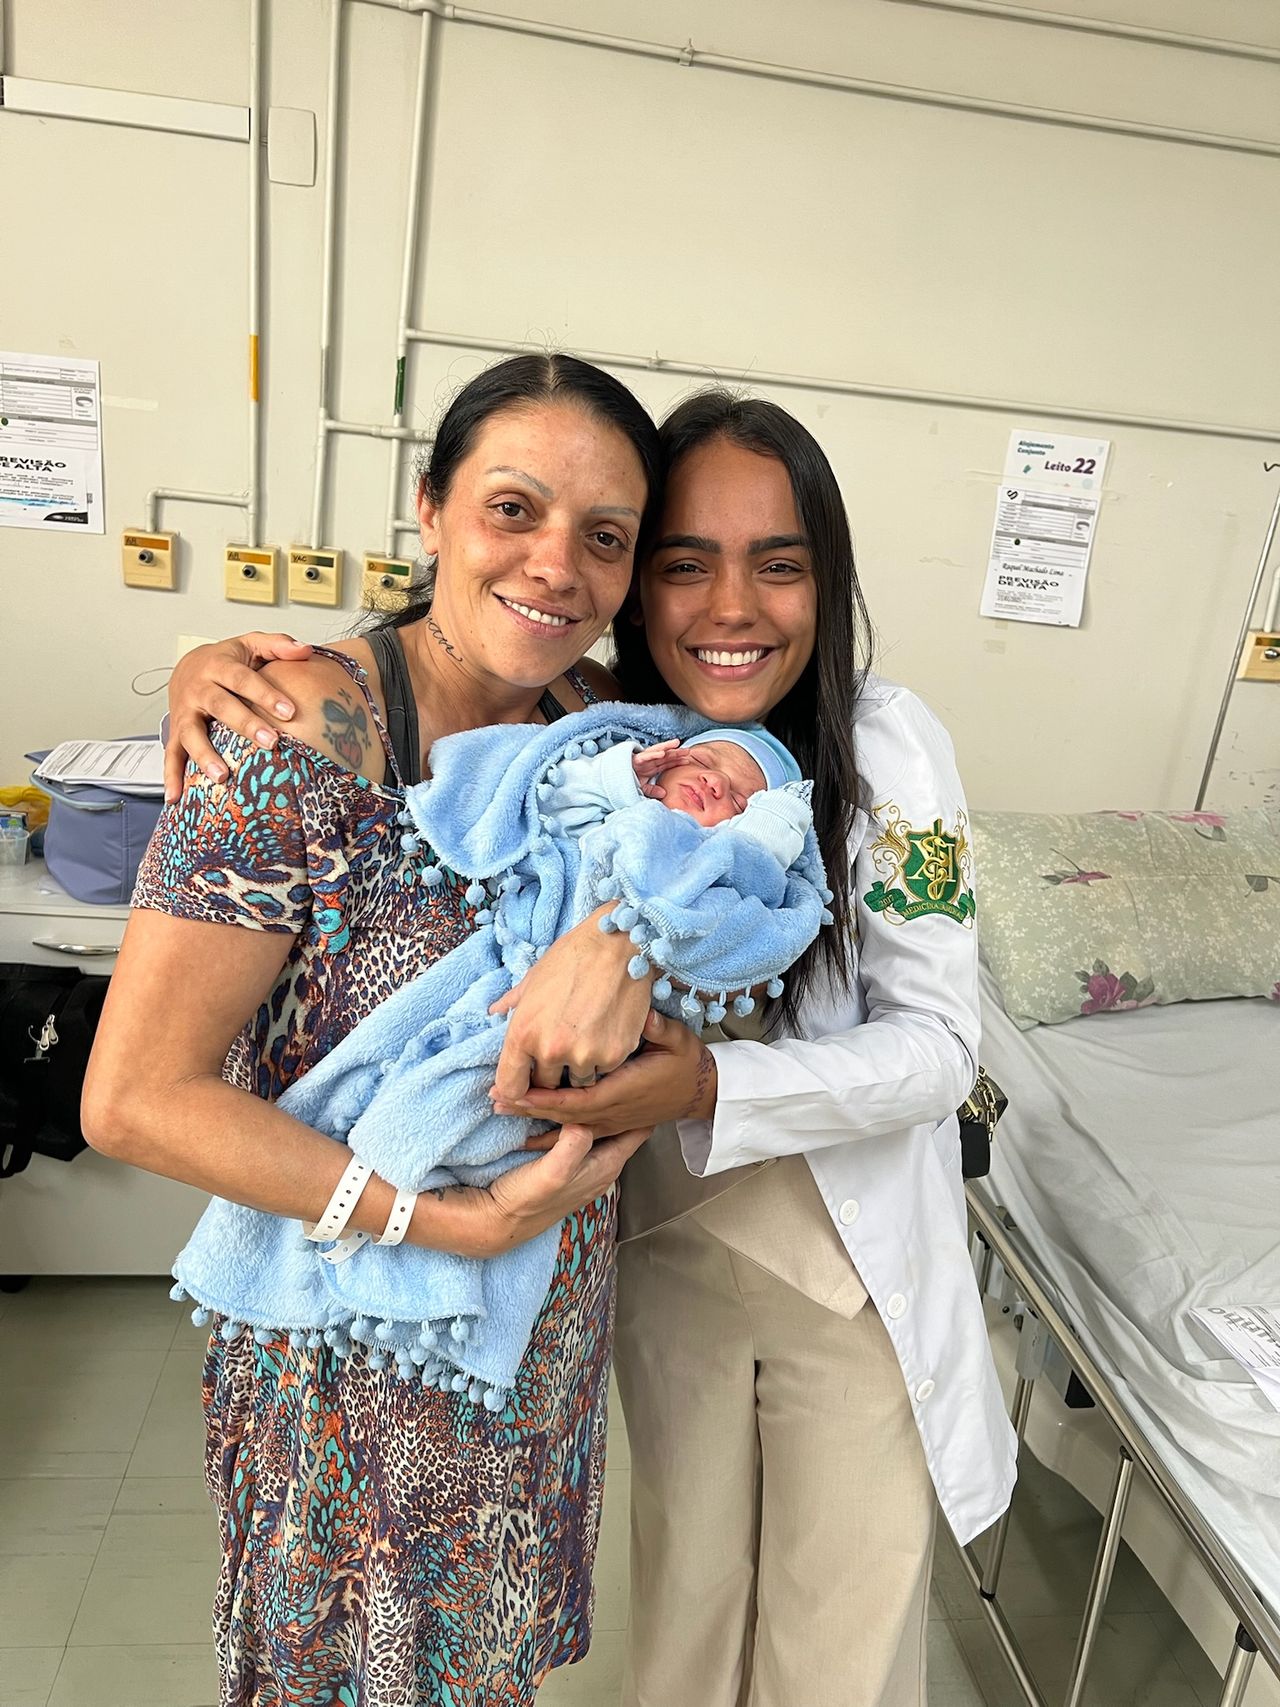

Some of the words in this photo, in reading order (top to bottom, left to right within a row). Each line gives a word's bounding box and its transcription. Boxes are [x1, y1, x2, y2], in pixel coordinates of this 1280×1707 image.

[0, 456, 67, 468] REVISÃO
[14, 463, 53, 472] ALTA
[1044, 460, 1072, 472] Leito
[1072, 457, 1097, 475] 22
[998, 575, 1059, 587] PREVISÃO
[1017, 582, 1047, 590] ALTA
